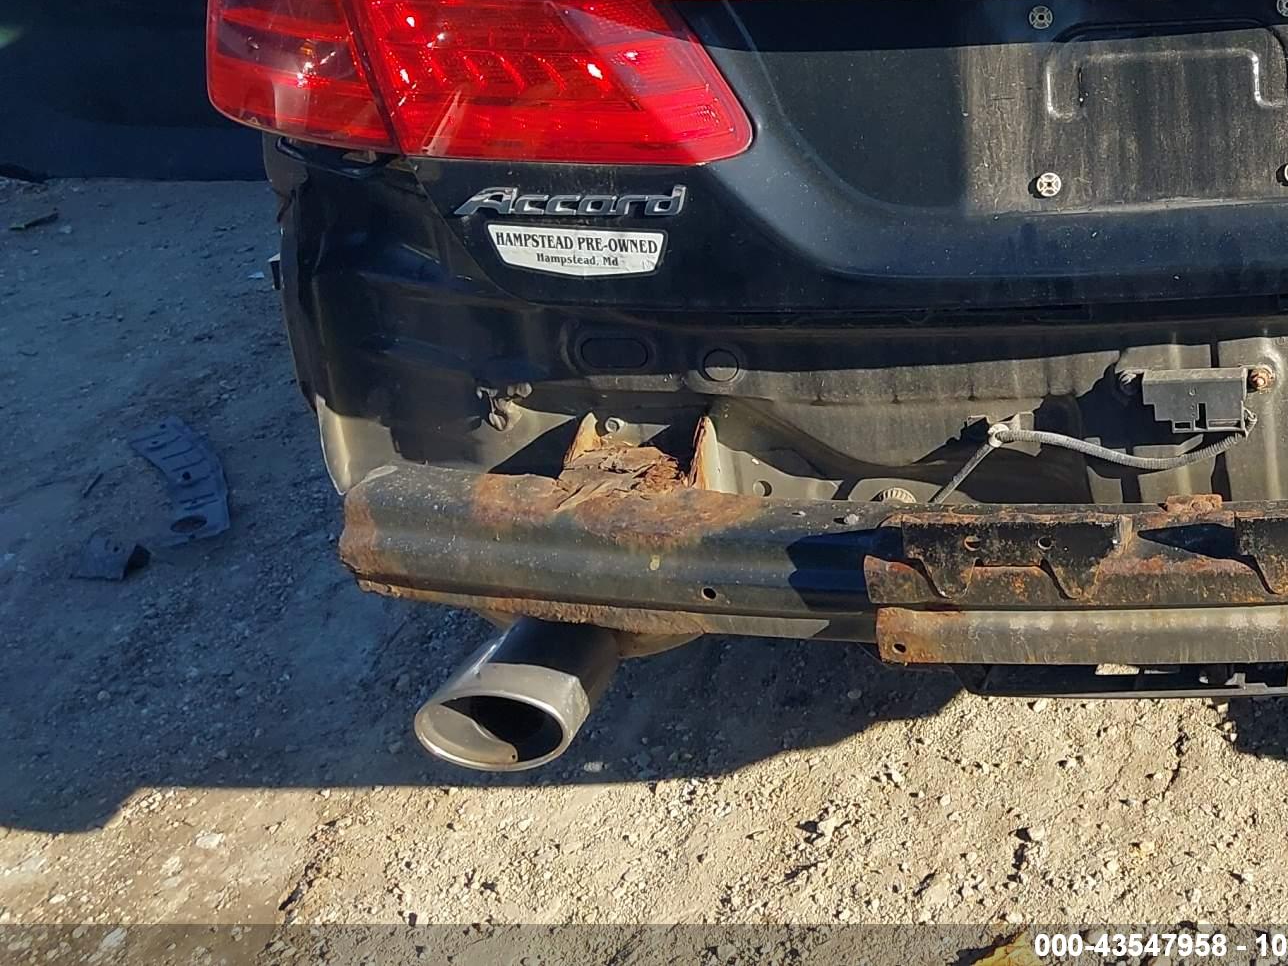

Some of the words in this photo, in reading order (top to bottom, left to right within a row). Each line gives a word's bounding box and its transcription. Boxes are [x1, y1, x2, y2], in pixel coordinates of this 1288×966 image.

[453, 185, 688, 216] Accord
[495, 231, 574, 251] HAMPSTEAD
[577, 237, 658, 254] PRE-OWNED
[536, 252, 600, 266] Hampstead,
[603, 256, 619, 266] Md
